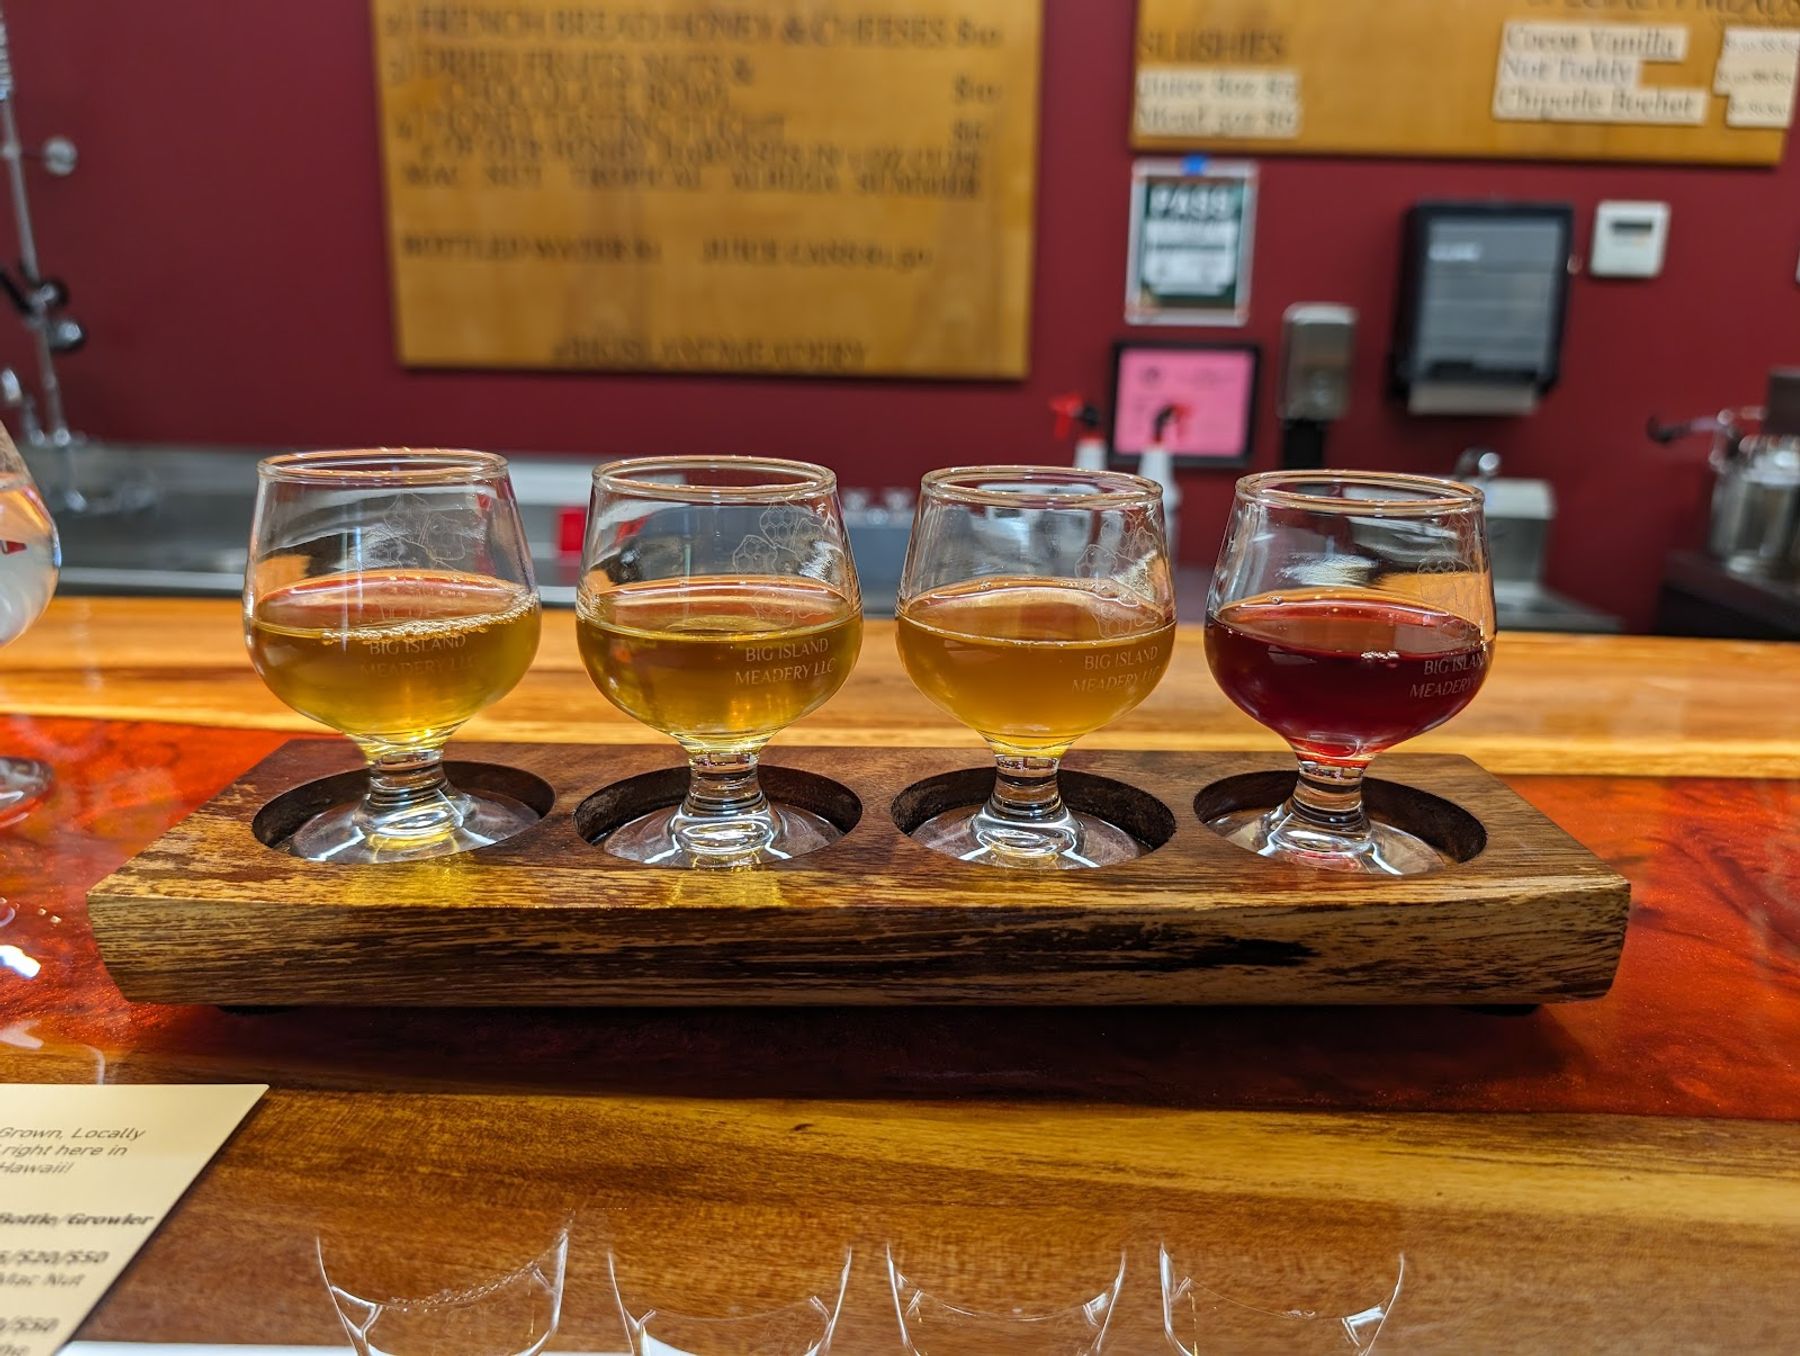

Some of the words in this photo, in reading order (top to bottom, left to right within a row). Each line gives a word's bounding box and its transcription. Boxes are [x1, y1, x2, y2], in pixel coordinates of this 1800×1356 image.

[370, 639, 400, 655] BIG
[405, 634, 466, 654] ISLAND
[746, 646, 774, 662] BIG
[778, 637, 829, 660] ISLAND
[359, 657, 447, 678] MEADERY
[1084, 654, 1111, 670] BIG
[1115, 646, 1159, 667] ISLAND
[1423, 658, 1449, 675] BIG
[735, 663, 813, 686] MEADERY
[814, 657, 837, 677] LLC
[1072, 672, 1140, 694] MEADERY
[0, 1127, 63, 1140] Grown,
[71, 1127, 146, 1142] Locally
[5, 1144, 54, 1158] right
[55, 1144, 104, 1156] here
[107, 1144, 129, 1156] in
[0, 1161, 75, 1174] Hawaii!
